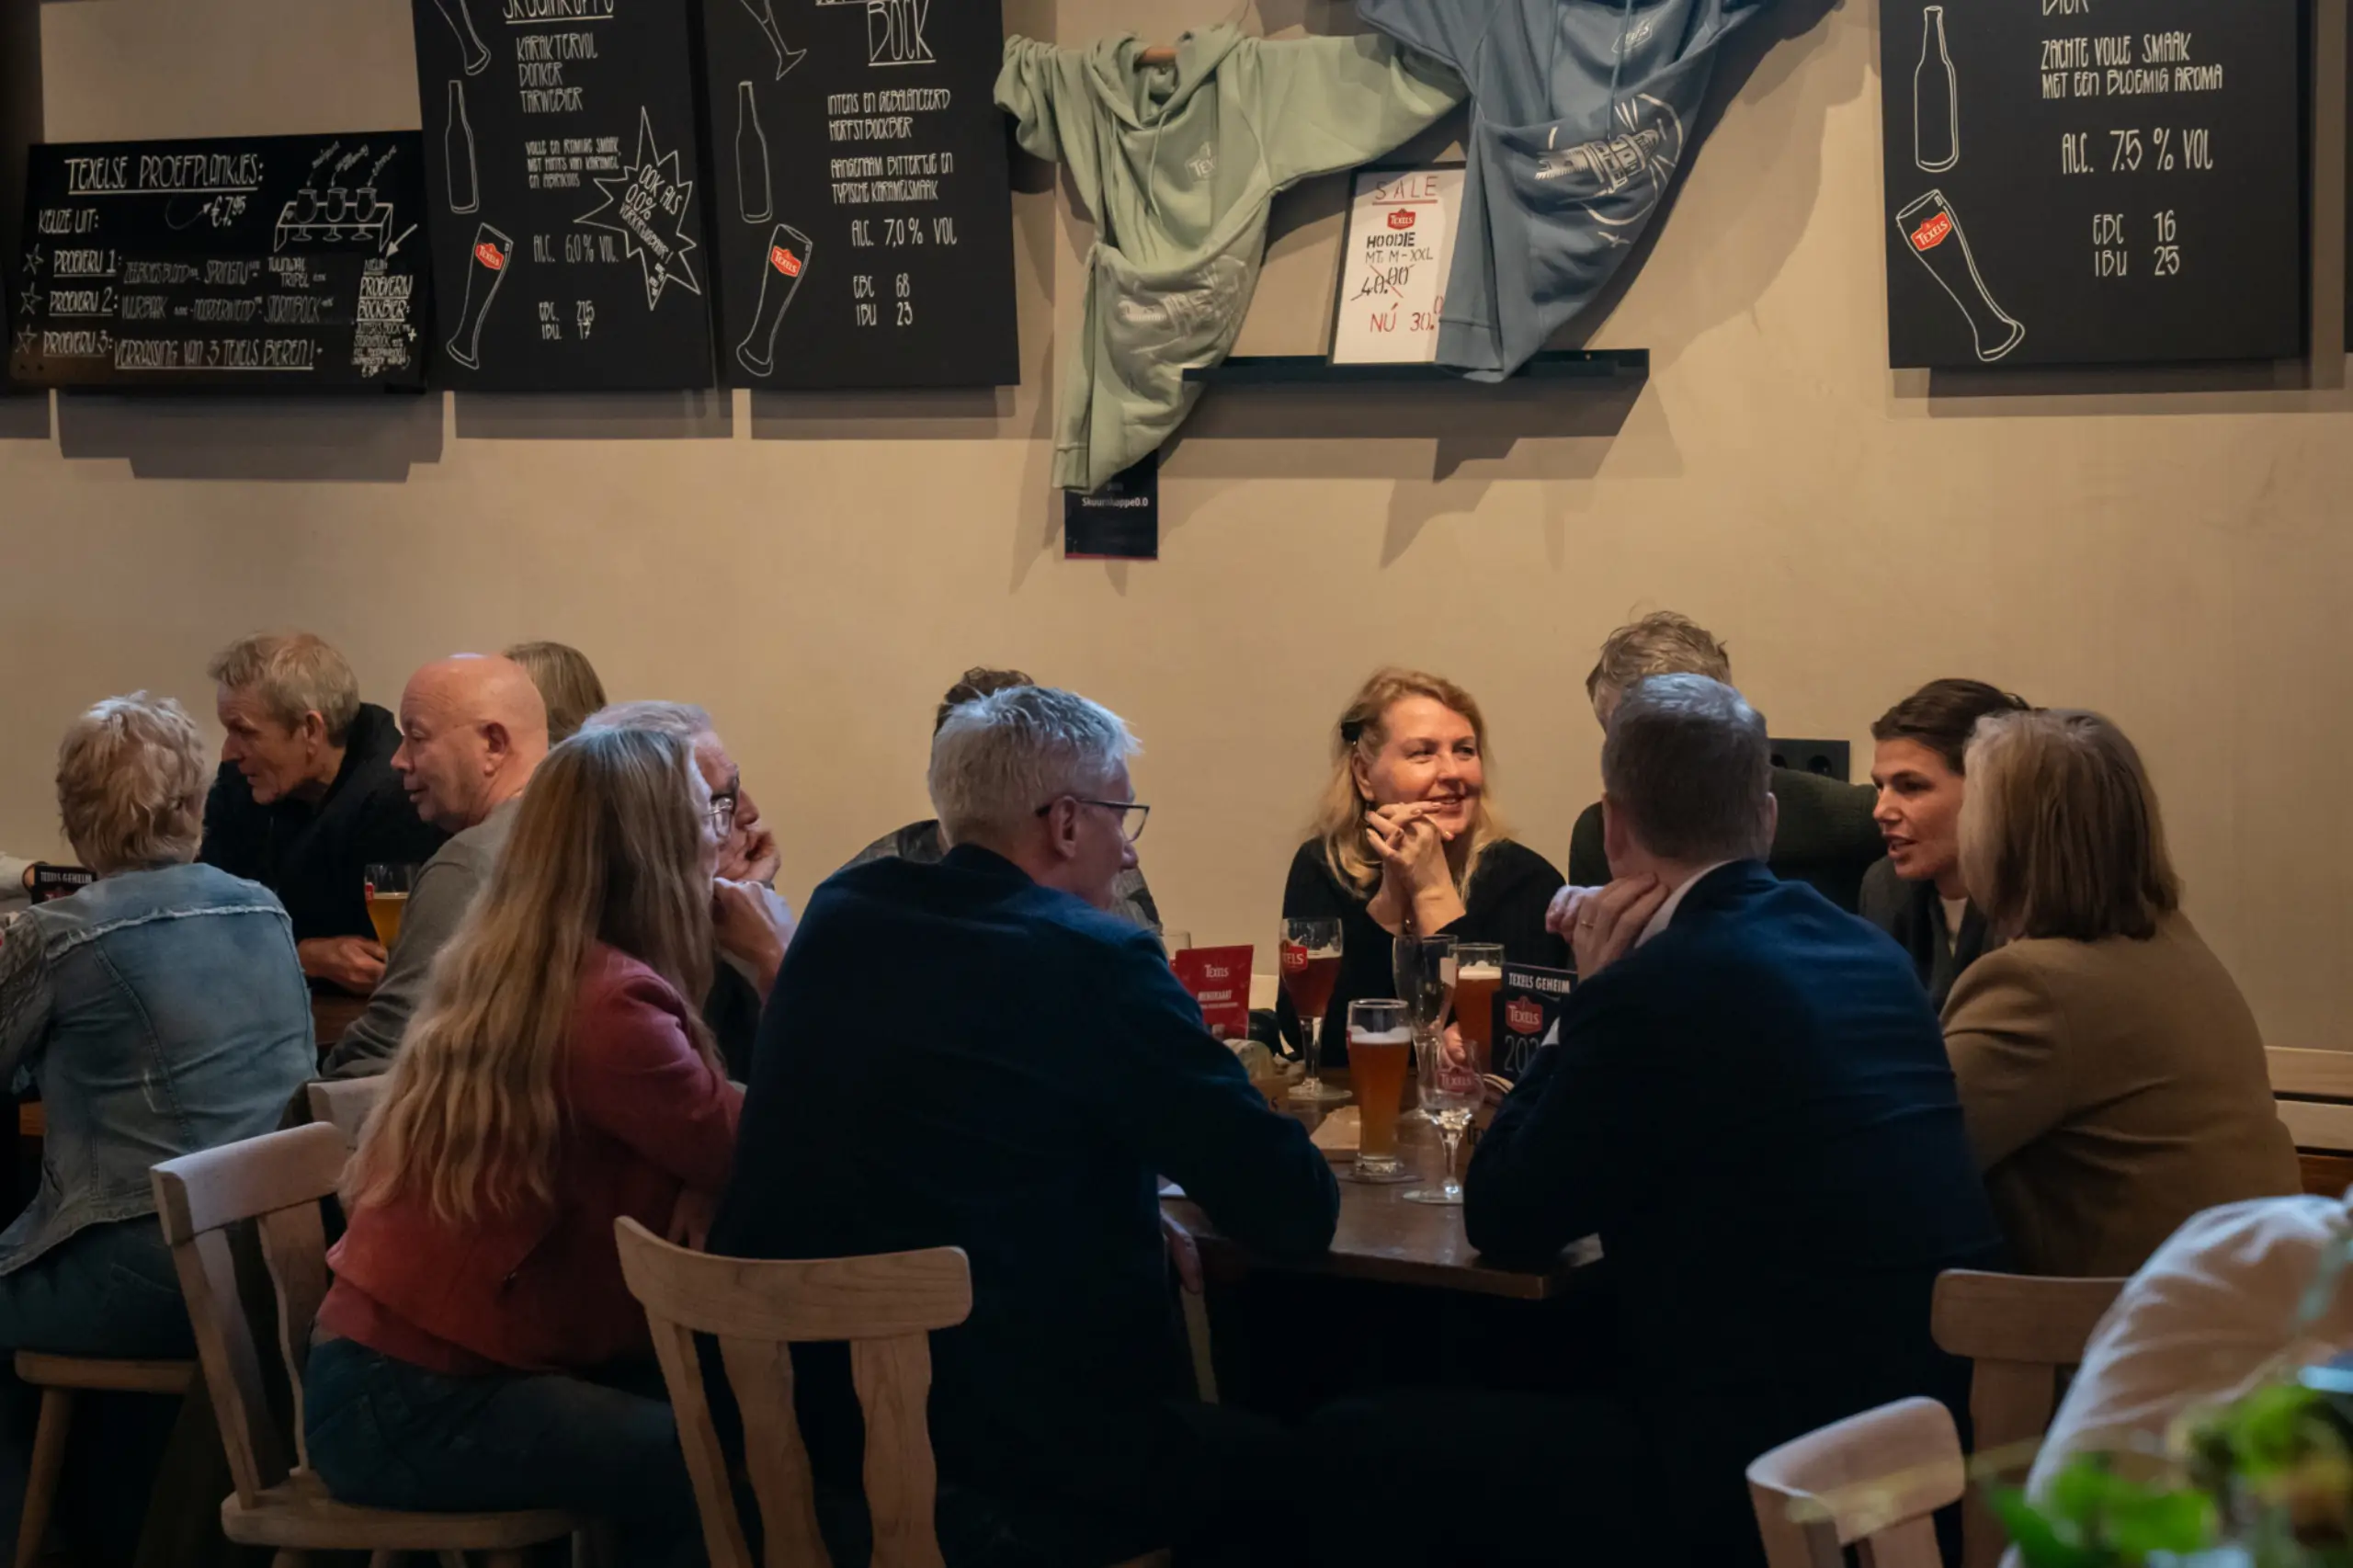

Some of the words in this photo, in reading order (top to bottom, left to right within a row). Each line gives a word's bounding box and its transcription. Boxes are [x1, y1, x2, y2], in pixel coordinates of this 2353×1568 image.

[867, 0, 934, 62] BOCK
[517, 32, 597, 62] KARAKTERVOL
[2040, 38, 2088, 71] ZACHTE
[2094, 36, 2131, 66] VOLLE
[2143, 30, 2192, 63] SMAAK
[518, 62, 563, 87] DONKER
[2042, 72, 2069, 99] MET
[2074, 71, 2099, 97] EEN
[2107, 68, 2169, 96] BLOEMIG
[2175, 63, 2222, 92] AROMA
[827, 94, 858, 115] INTENS
[863, 92, 876, 113] EN
[879, 88, 950, 112] GEBALANCEERD
[2063, 132, 2094, 175] ALC.
[2183, 128, 2213, 169] VOL
[64, 156, 128, 190] TEXELSE
[831, 156, 883, 178] AANGENAAM
[887, 153, 937, 176] BITTERTJE
[941, 153, 953, 174] EN
[639, 164, 665, 198] OOK
[660, 185, 682, 215] ALS
[831, 182, 870, 204] TYPISCHE
[1375, 176, 1438, 200] SALE
[933, 218, 957, 244] VOL
[1391, 214, 1414, 225] TEXELS
[2093, 213, 2124, 244] EBC
[2153, 210, 2176, 243] 16
[1367, 232, 1415, 249] HOODIE
[1915, 221, 1948, 245] TEXELS
[775, 250, 797, 274] TEXELS
[2095, 249, 2127, 277] IBU
[2154, 245, 2180, 276] 25
[853, 275, 875, 299] EBC
[896, 273, 910, 298] 68
[856, 304, 877, 326] IBU
[896, 301, 913, 325] 23
[1370, 302, 1398, 333] NÚ
[206, 340, 220, 366] 3
[1204, 964, 1229, 978] TEXELS
[1508, 972, 1533, 989] TEXELS
[1536, 976, 1571, 994] GEHEIM
[1507, 1005, 1540, 1025] TEXELS
